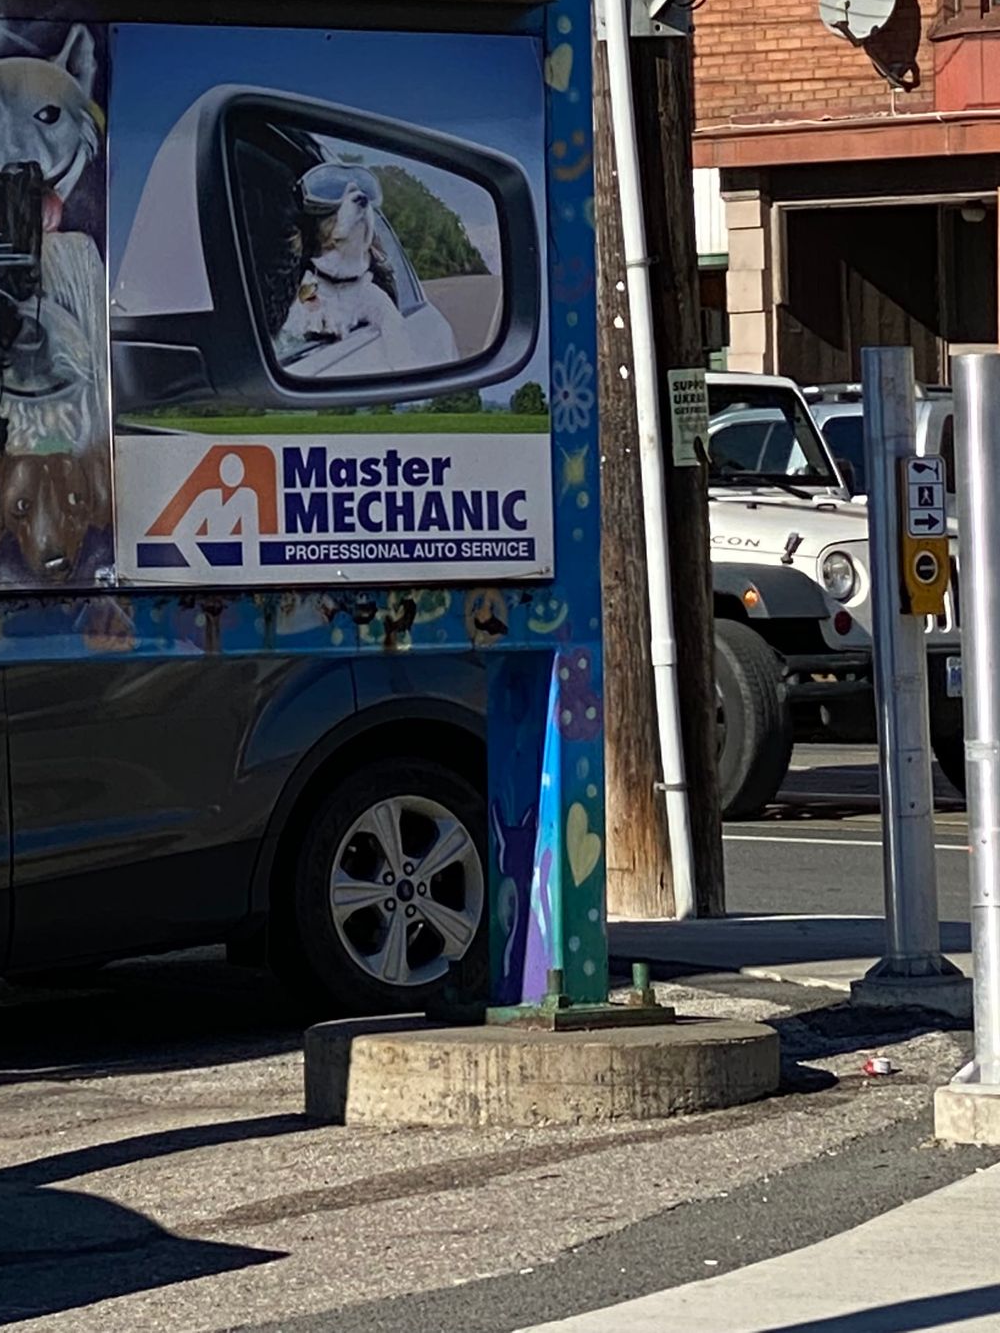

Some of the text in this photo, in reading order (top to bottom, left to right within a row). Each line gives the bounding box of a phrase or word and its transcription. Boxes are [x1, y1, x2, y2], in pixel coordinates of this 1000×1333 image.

[282, 446, 452, 489] Master
[283, 489, 528, 534] MECHANIC
[284, 541, 529, 561] PROFESSIONAL AUTO SERVICE
